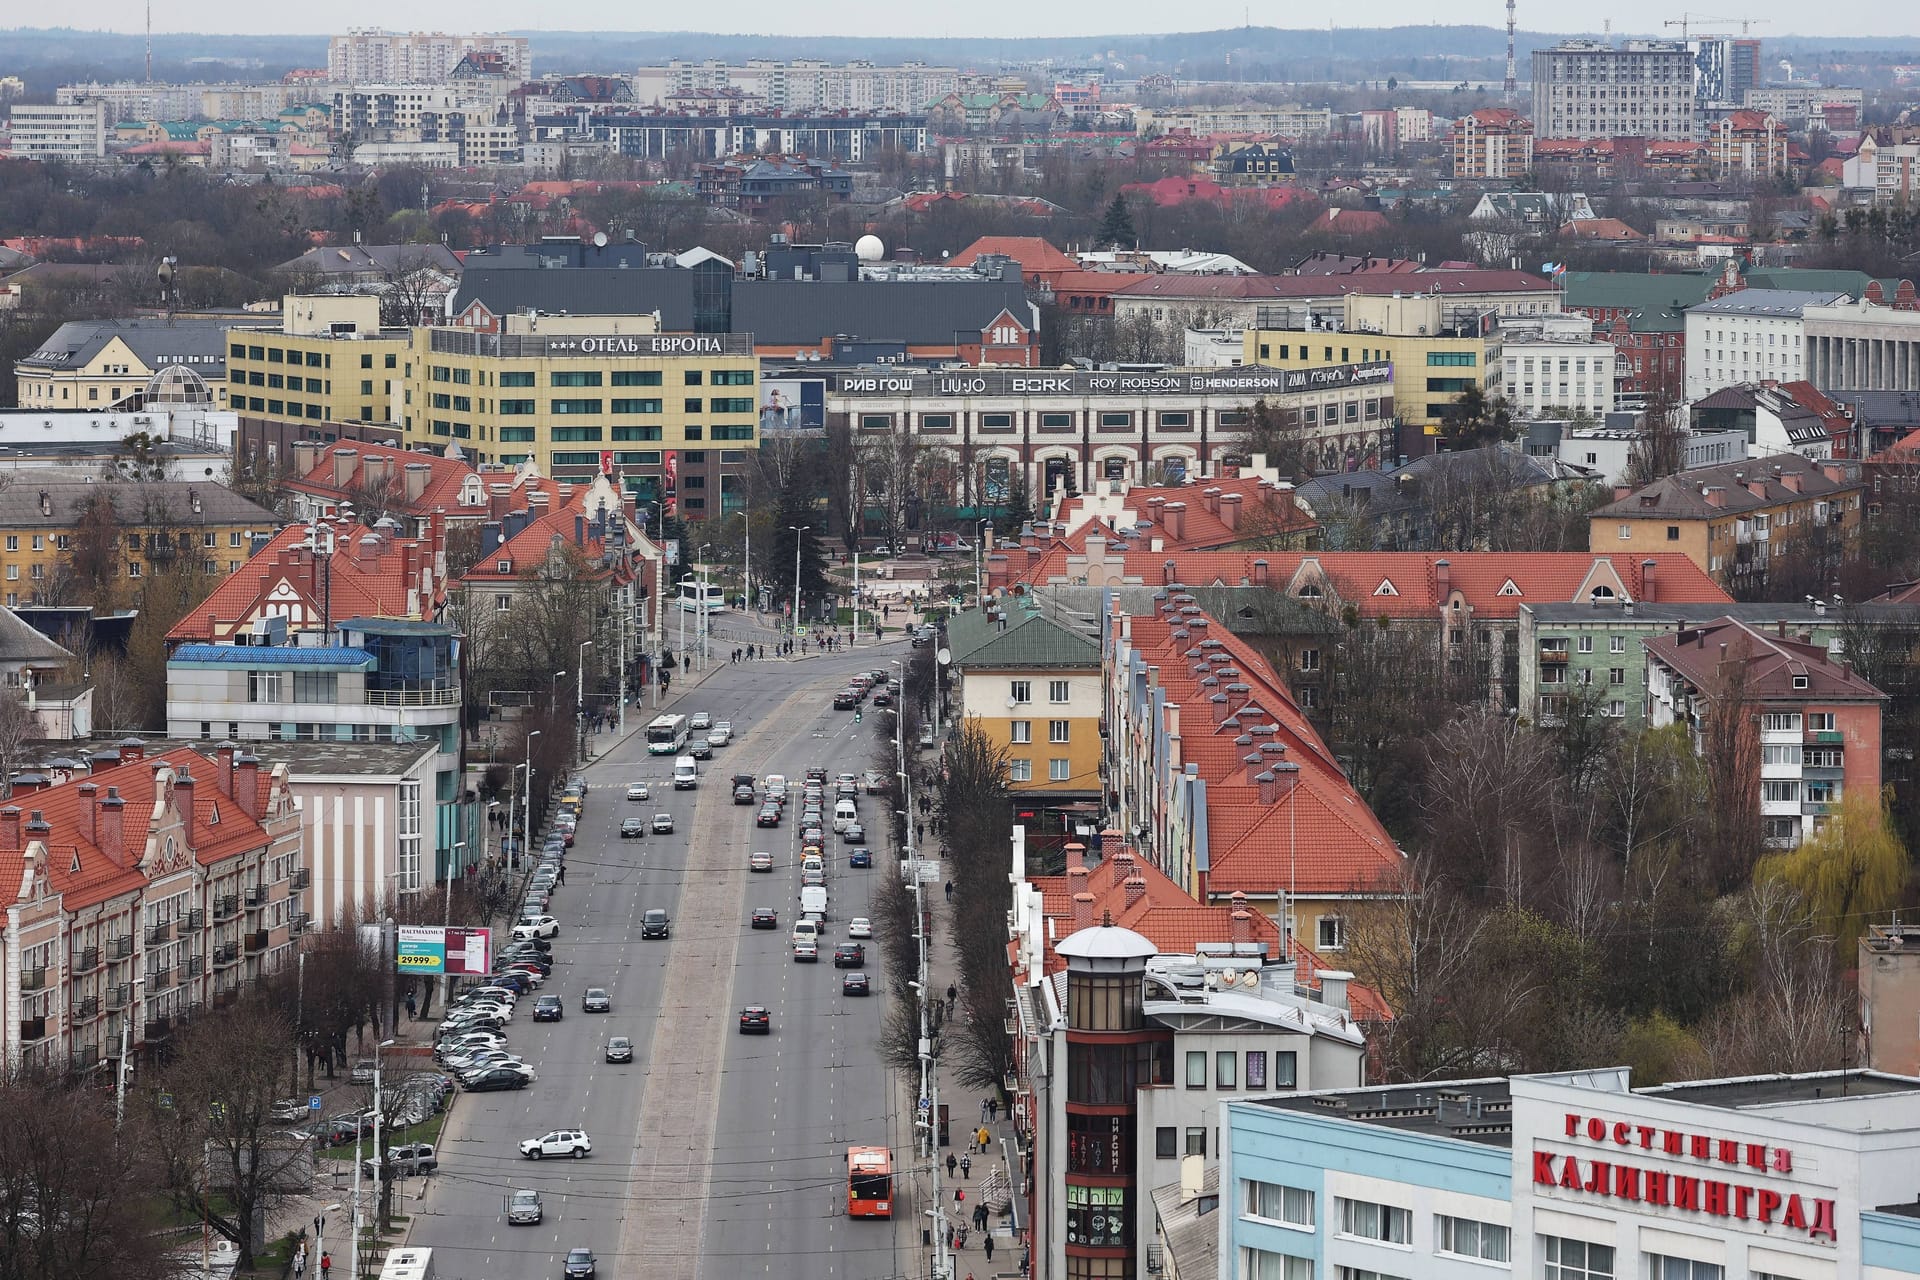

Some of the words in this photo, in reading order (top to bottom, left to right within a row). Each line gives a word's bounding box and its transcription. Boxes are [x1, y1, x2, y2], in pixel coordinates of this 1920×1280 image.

[581, 337, 638, 352] ОТЕЛЬ
[652, 337, 722, 352] ЕВРОПА
[844, 378, 877, 391] РИВ
[879, 378, 912, 391] ГОШ
[1012, 378, 1072, 391] BORK
[1090, 378, 1118, 389] ROY
[1121, 378, 1181, 389] ROBSON
[1205, 377, 1279, 388] HENDERSON
[1111, 1117, 1119, 1173] ПИРСИНГ
[1532, 1151, 1838, 1242] КАЛИНИНГРАД
